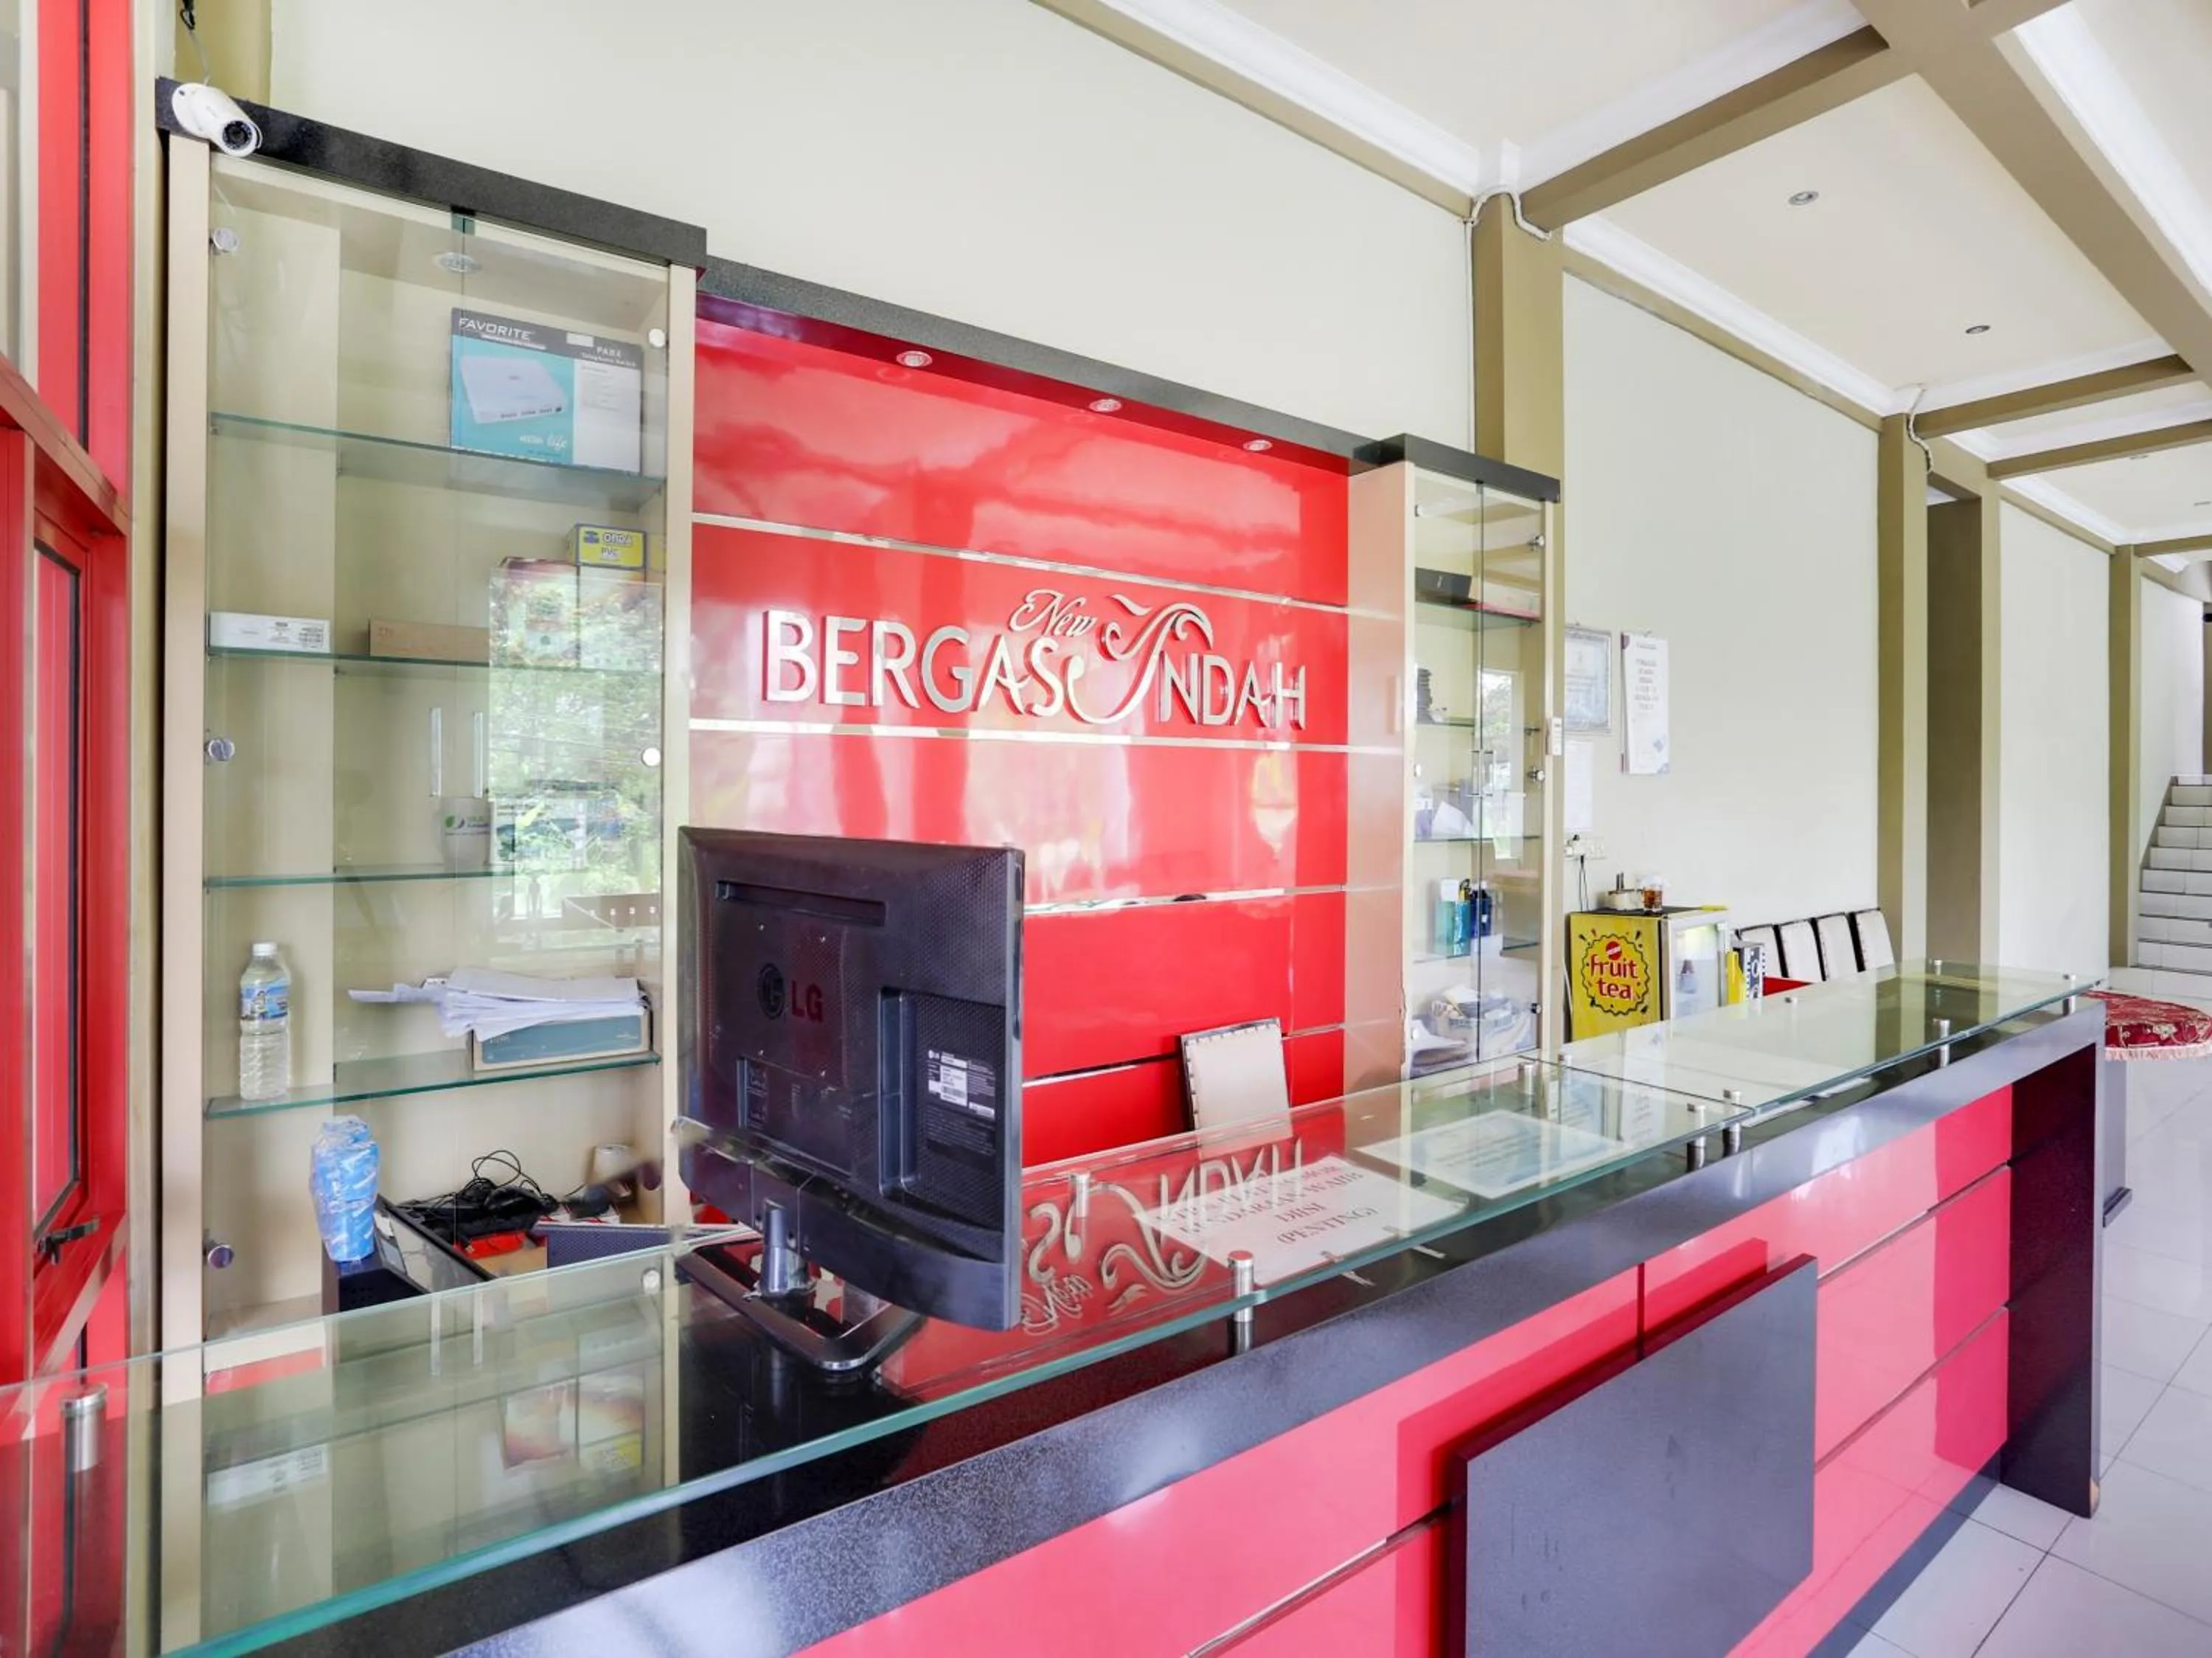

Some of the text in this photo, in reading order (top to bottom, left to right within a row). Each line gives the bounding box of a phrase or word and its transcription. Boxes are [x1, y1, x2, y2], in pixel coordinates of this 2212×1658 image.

[459, 317, 532, 341] FAVORITE
[1008, 589, 1096, 637] New
[762, 609, 1068, 717] BERGAS
[1590, 954, 1638, 979] fruit
[790, 979, 824, 1023] LG
[1597, 977, 1632, 1001] tea
